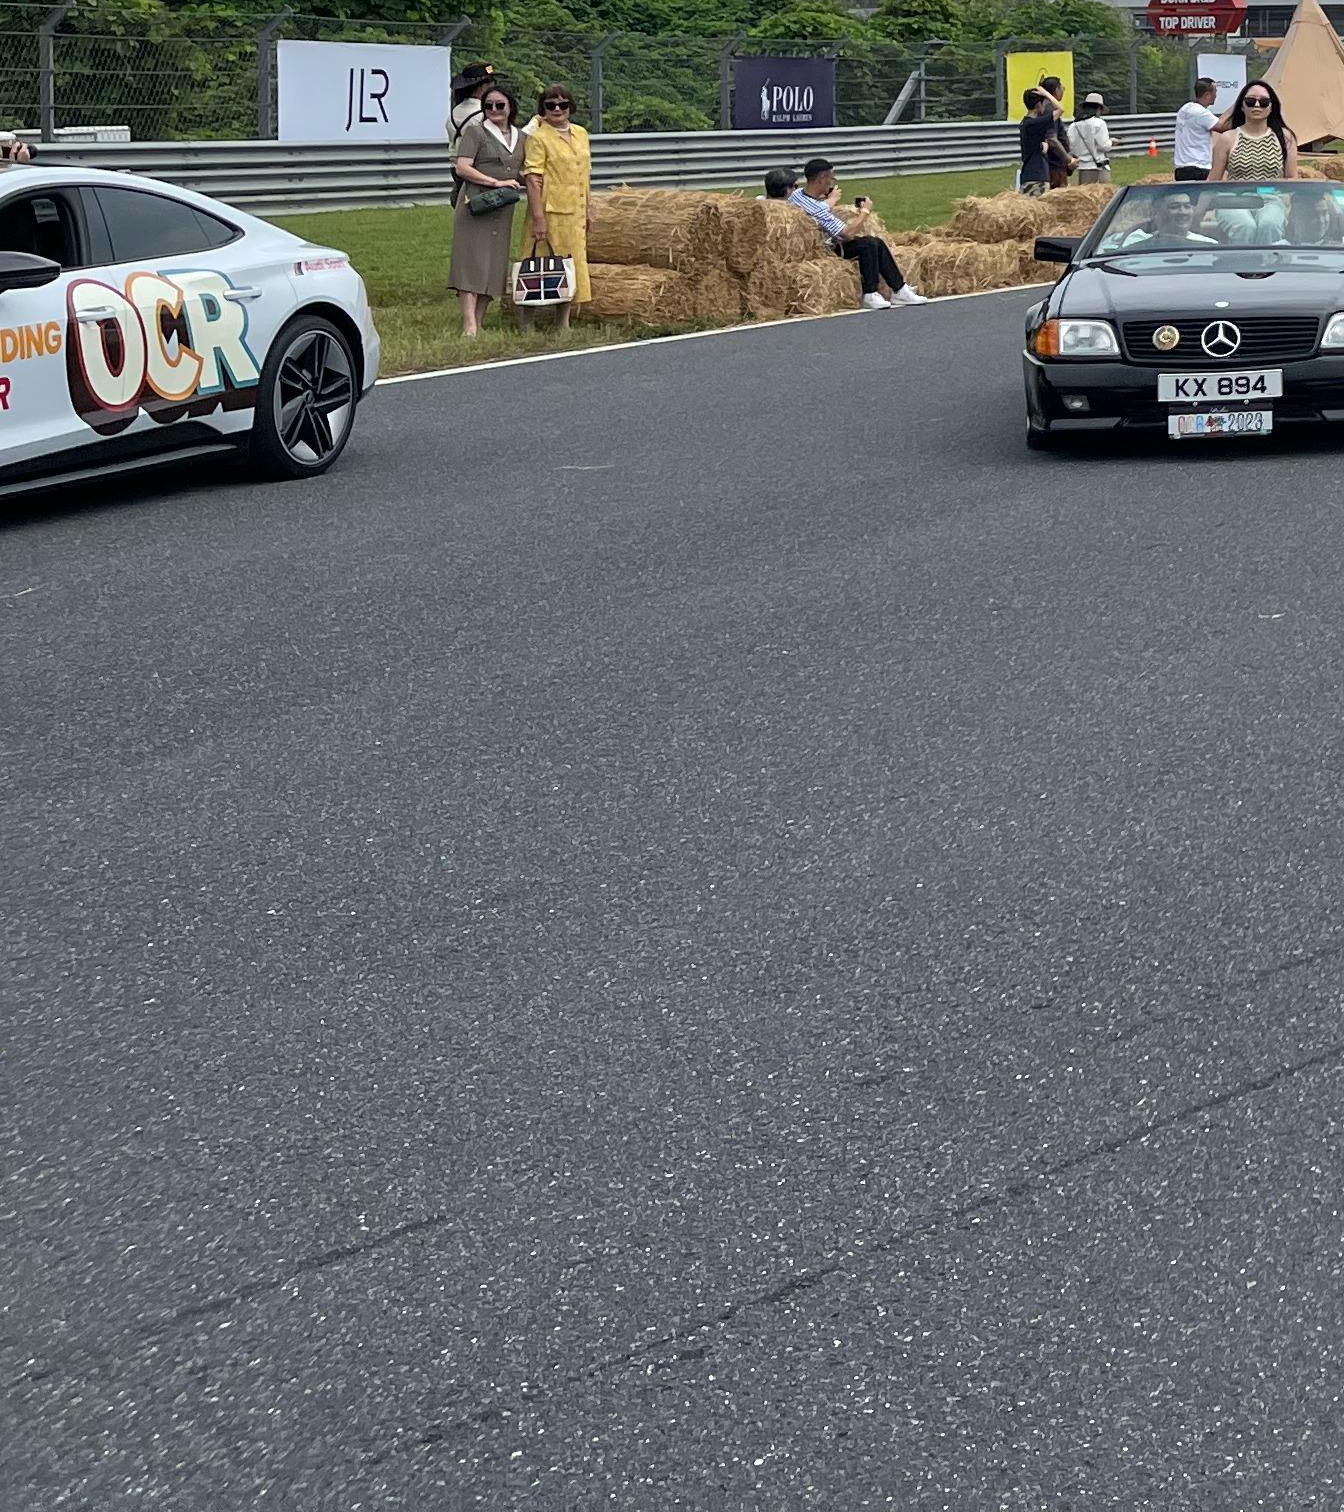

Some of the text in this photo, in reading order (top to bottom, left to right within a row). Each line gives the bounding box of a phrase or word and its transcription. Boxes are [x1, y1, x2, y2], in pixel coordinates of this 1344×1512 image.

[1159, 17, 1216, 30] TOP DRIVER
[345, 68, 389, 133] JLR
[772, 86, 814, 112] POLO
[66, 267, 263, 414] OCR
[1175, 375, 1267, 397] KX 894
[1228, 412, 1264, 432] 2023
